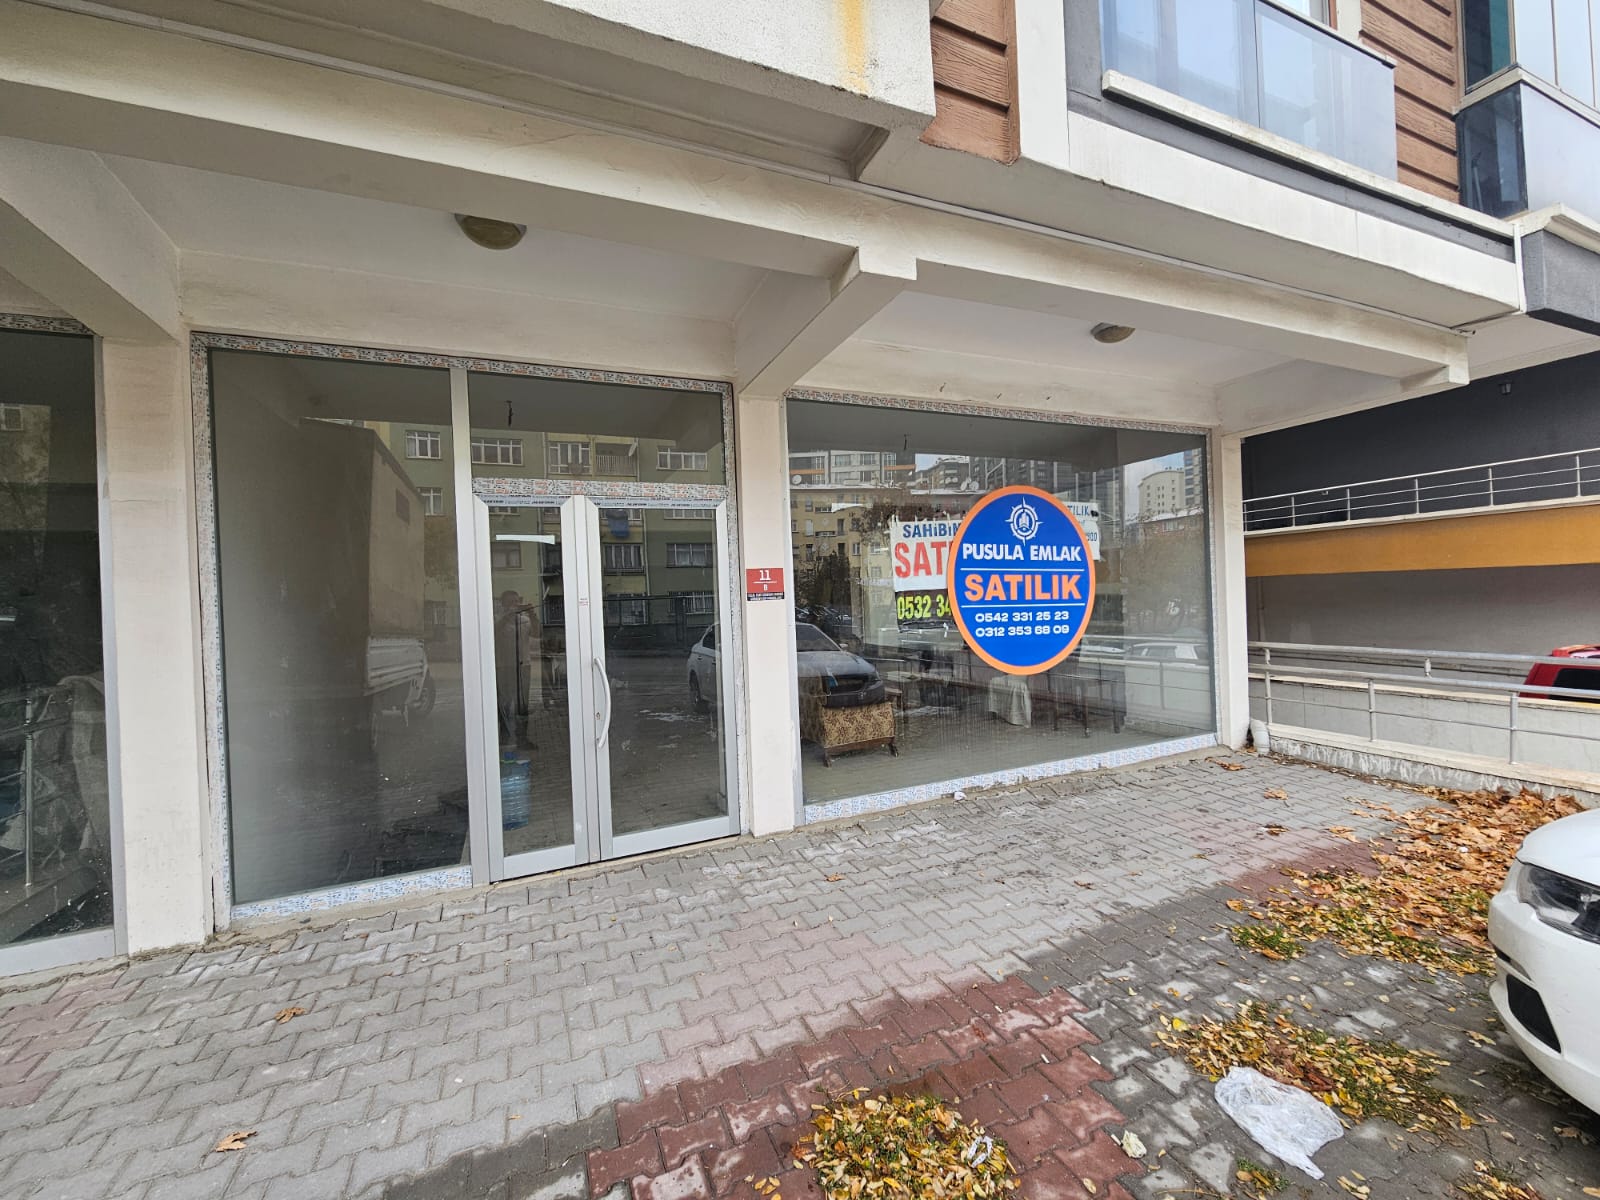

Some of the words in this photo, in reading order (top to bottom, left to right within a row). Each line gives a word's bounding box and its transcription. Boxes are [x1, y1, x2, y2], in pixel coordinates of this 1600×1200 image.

[962, 543, 1024, 560] PUSULA
[1030, 545, 1082, 561] EMLAK
[760, 570, 771, 580] 11
[964, 574, 1082, 602] SATILIK
[897, 594, 932, 620] 0532
[975, 612, 1009, 622] 0542
[1012, 612, 1033, 622] 331
[1035, 611, 1051, 621] 25
[1054, 610, 1070, 620] 23
[975, 627, 1005, 637] 0312
[1007, 626, 1032, 636] 353
